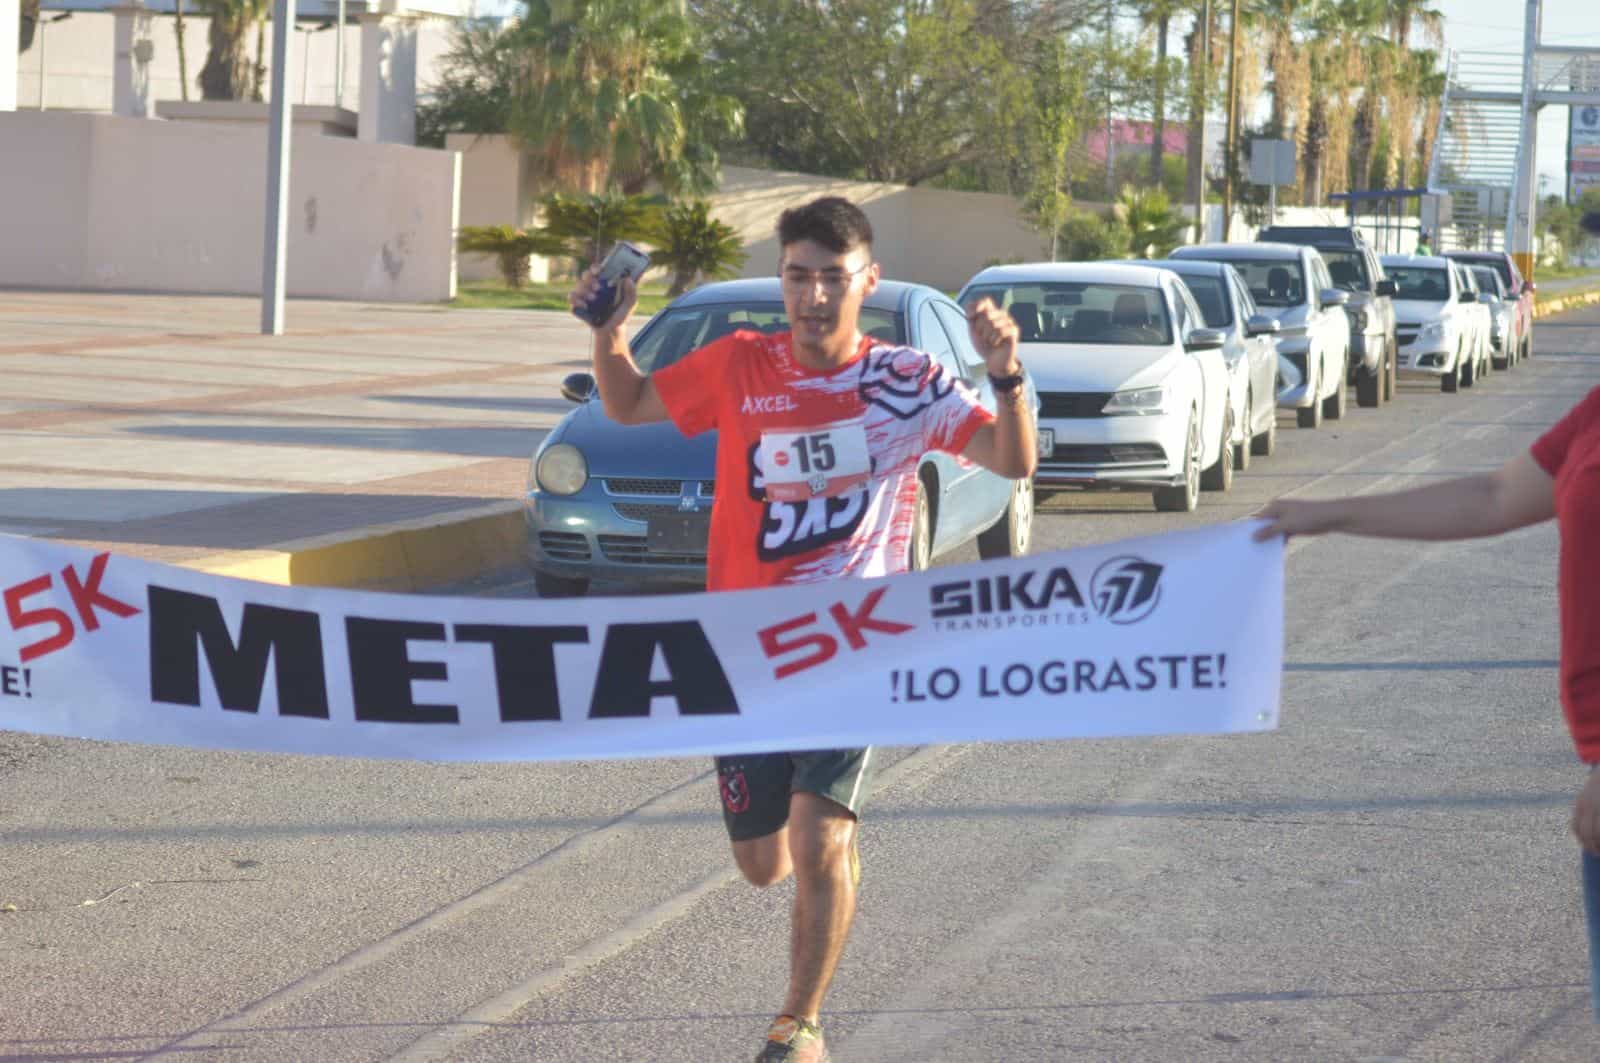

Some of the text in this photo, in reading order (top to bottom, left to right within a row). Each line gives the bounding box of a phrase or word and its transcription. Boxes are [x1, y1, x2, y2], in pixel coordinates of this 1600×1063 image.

[741, 394, 799, 415] AXCEL
[791, 432, 836, 474] 15
[930, 566, 1085, 618] SIKA
[3, 551, 916, 724] 5K META 5K
[932, 611, 1090, 633] TRANSPORTES
[979, 653, 1227, 698] LOGRASTE!
